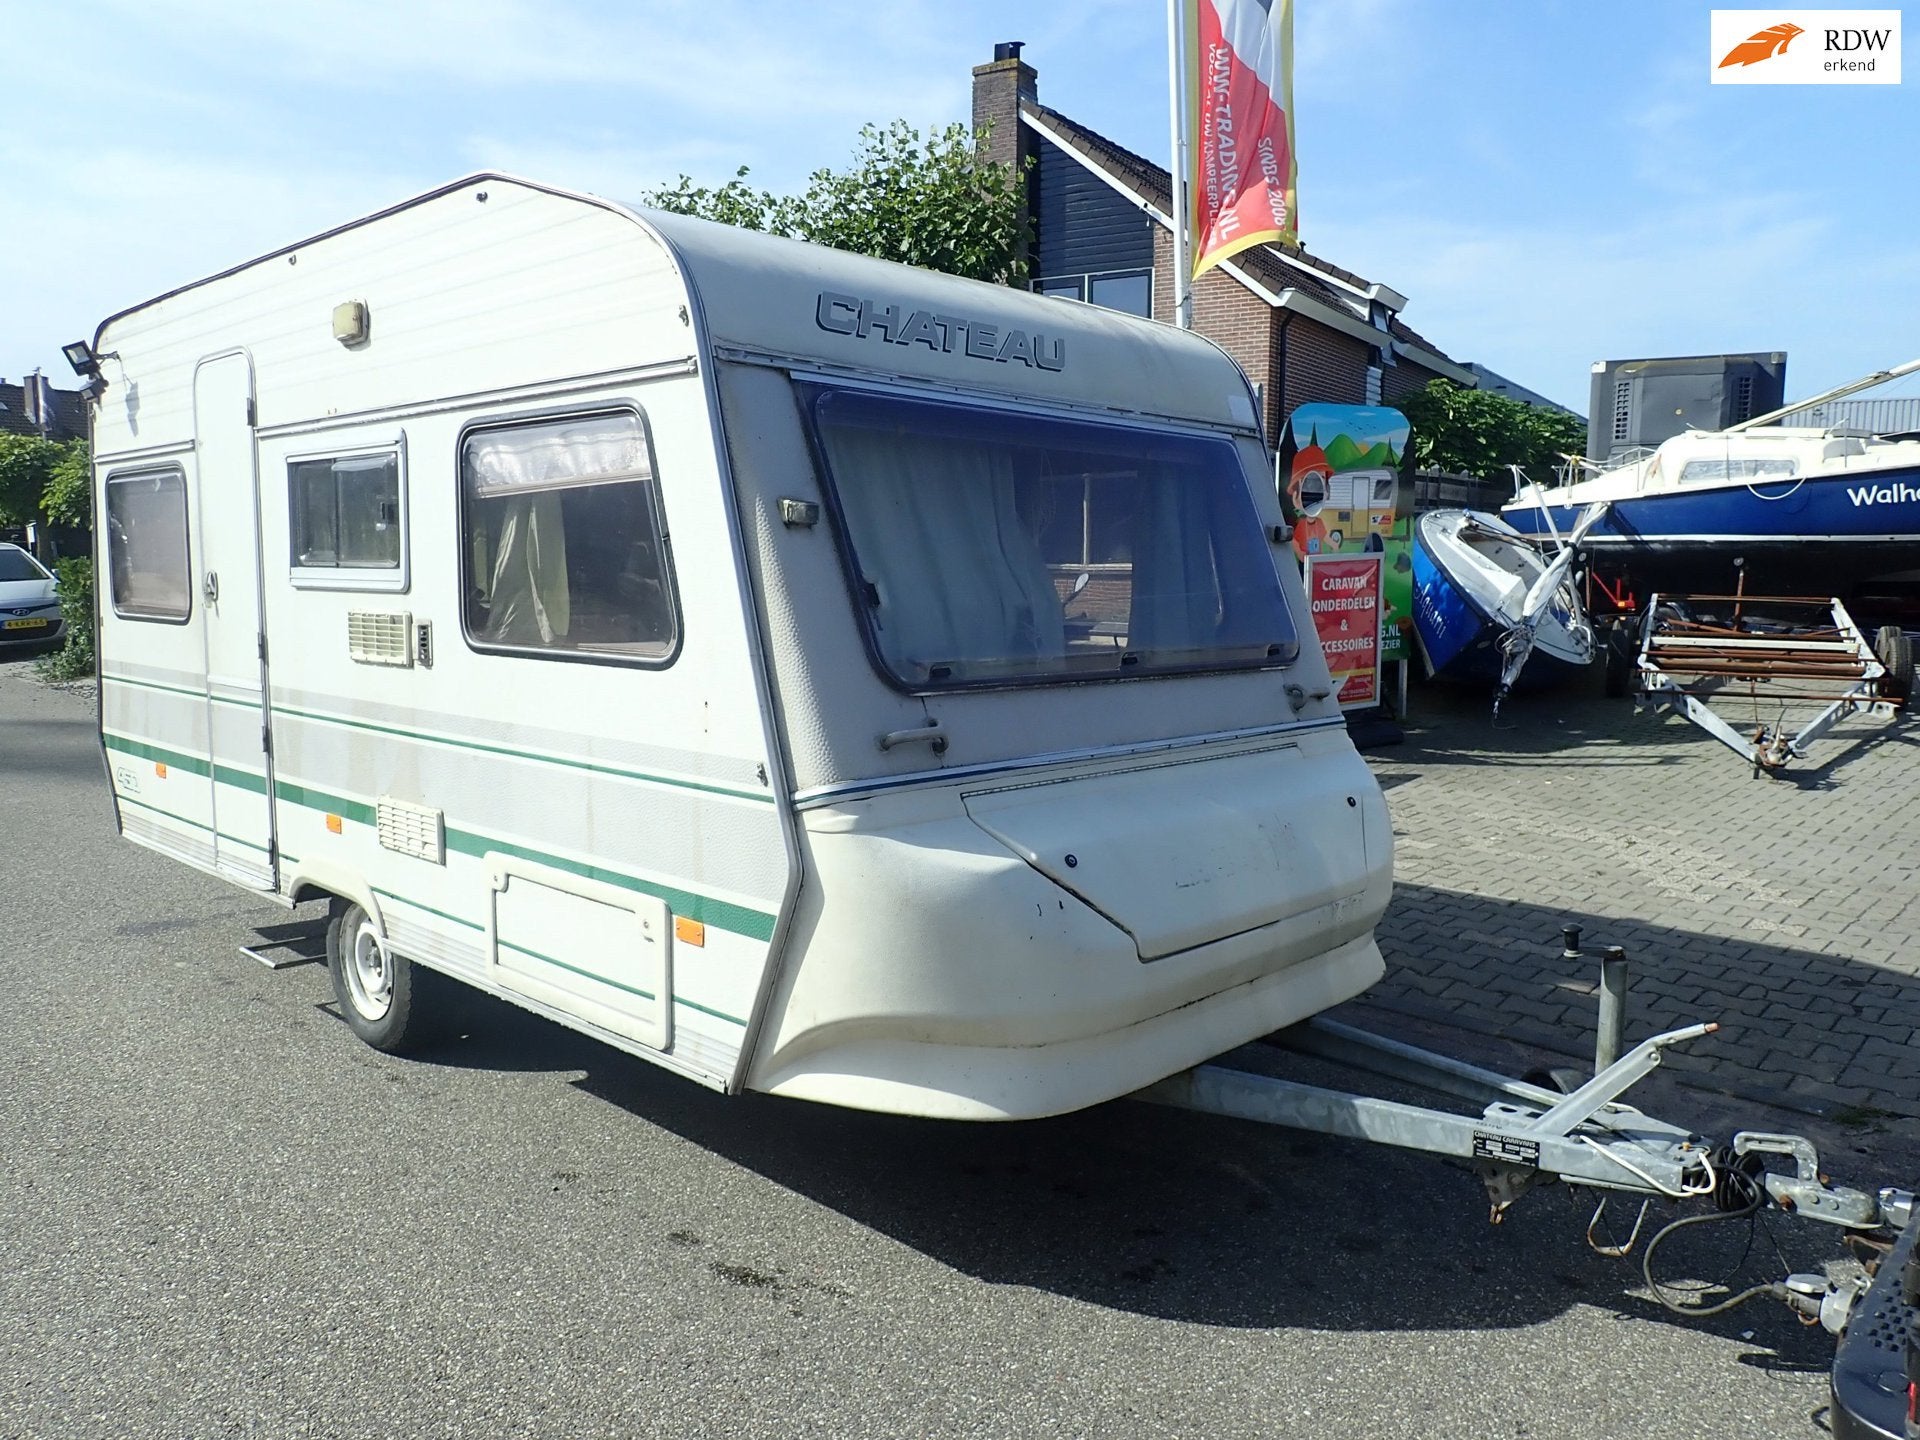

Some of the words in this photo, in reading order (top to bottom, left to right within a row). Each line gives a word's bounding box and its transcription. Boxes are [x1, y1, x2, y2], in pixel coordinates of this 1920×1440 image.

[815, 290, 1066, 373] CHATEAU
[1322, 576, 1367, 591] CARAVAN
[1312, 596, 1376, 613] ONDERDELEN
[1340, 619, 1348, 631] &
[1320, 637, 1374, 653] CCESSOIRES
